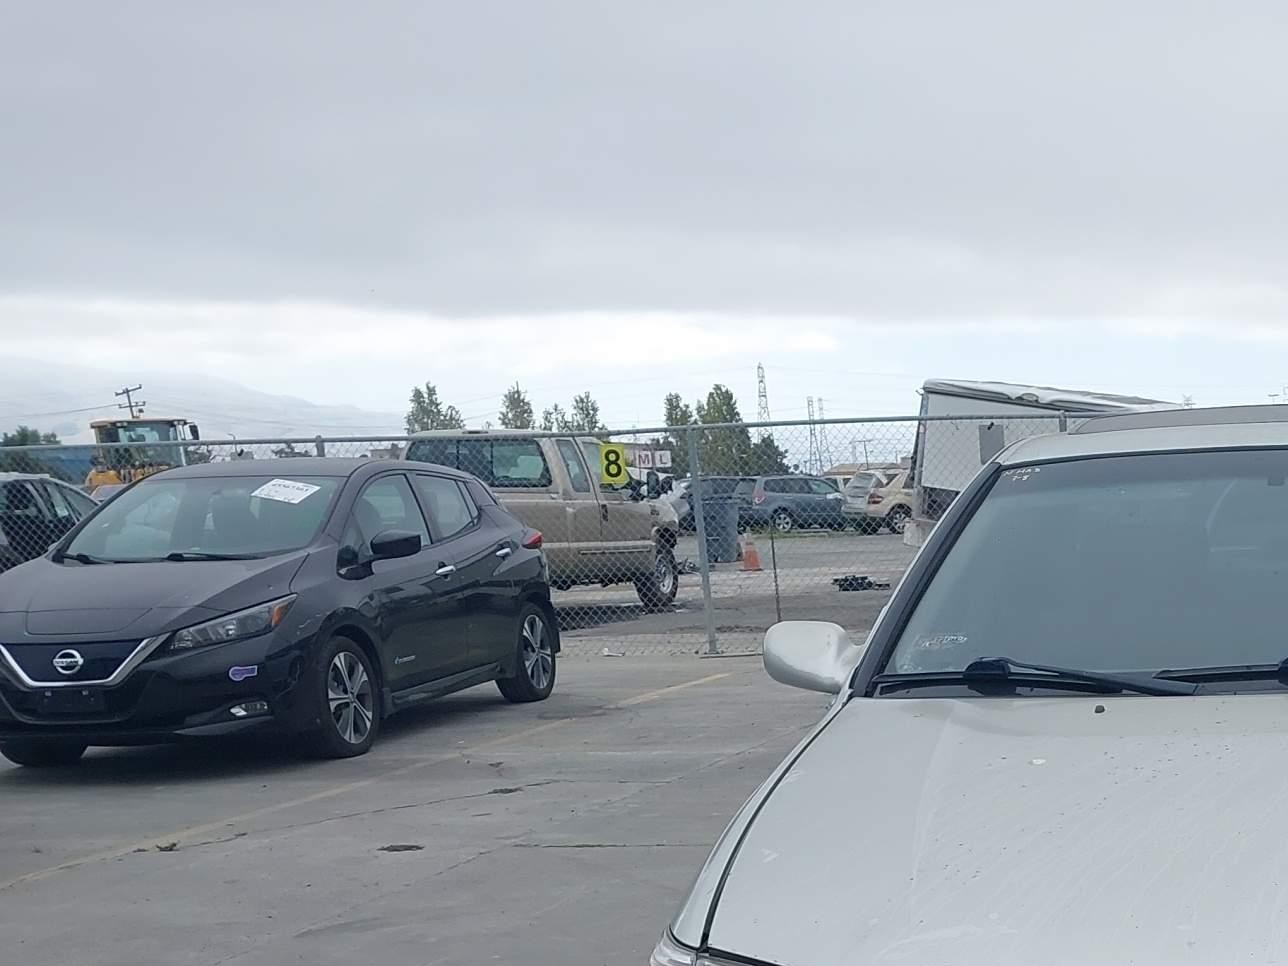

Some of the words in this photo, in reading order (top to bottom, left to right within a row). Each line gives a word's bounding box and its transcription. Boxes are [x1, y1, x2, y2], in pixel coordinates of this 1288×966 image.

[604, 449, 622, 478] 8
[638, 453, 650, 465] M
[659, 454, 668, 465] L
